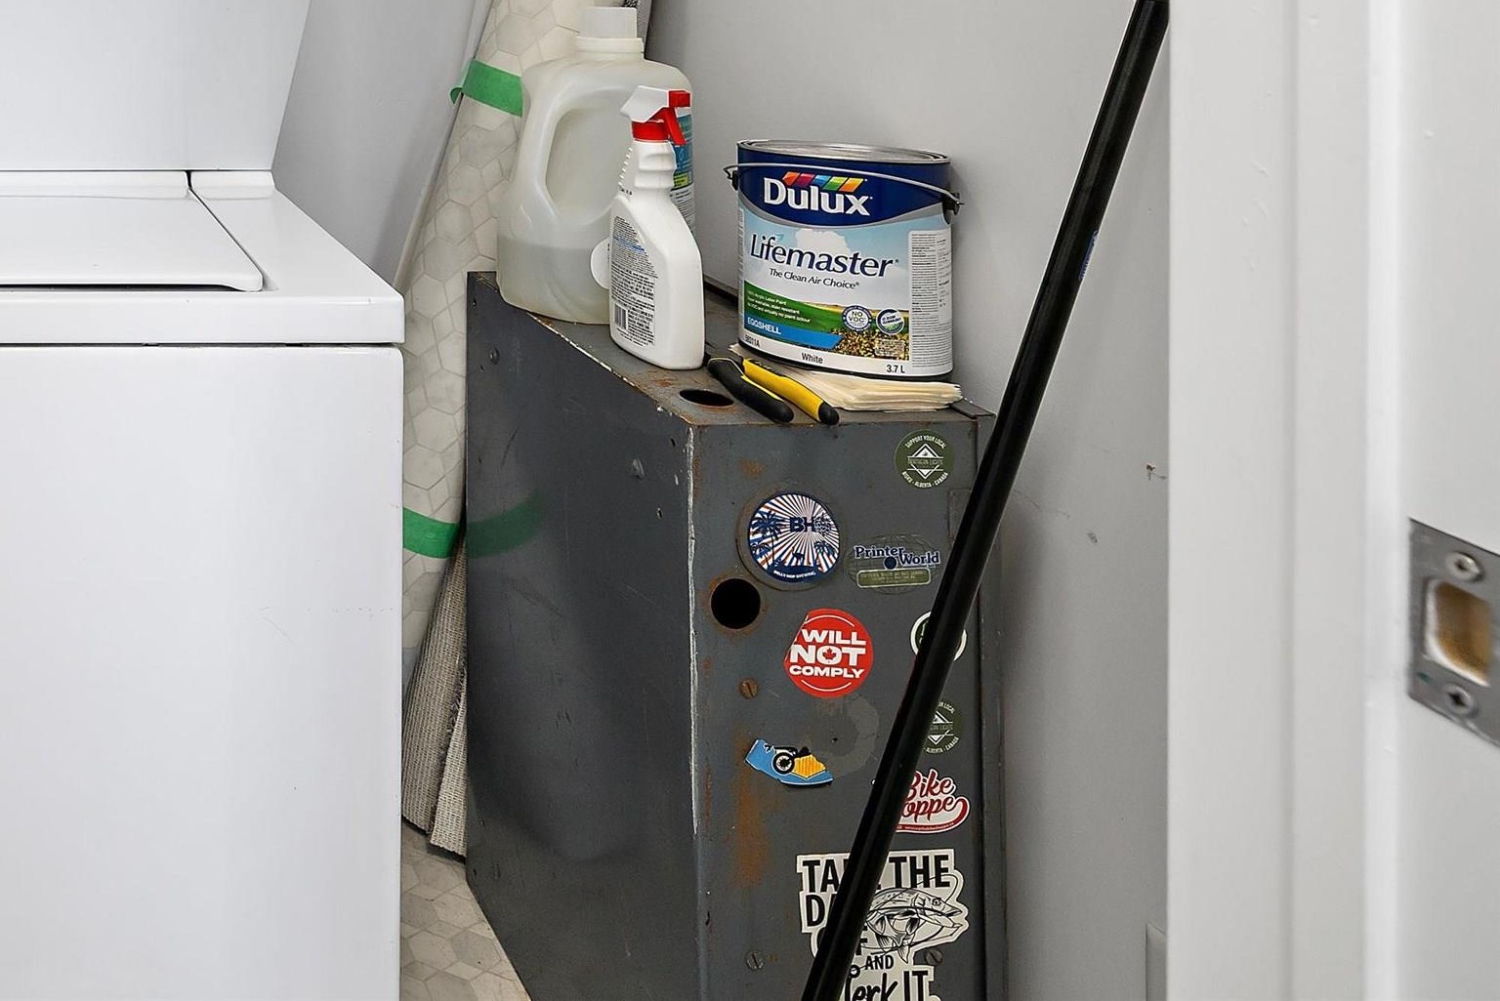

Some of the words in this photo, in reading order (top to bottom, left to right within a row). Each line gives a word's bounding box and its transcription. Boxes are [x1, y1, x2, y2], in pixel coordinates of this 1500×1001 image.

[763, 177, 871, 216] Dulux
[750, 233, 894, 277] Lifemaster
[769, 268, 783, 278] The
[784, 271, 808, 284] Clean
[808, 275, 821, 286] Air
[747, 317, 781, 335] EGGSHELL
[801, 352, 824, 364] White
[886, 364, 898, 373] 3.7
[900, 364, 906, 374] L
[904, 435, 923, 448] SUPPORT
[934, 438, 947, 449] LOCAL
[934, 472, 949, 486] CANADA
[790, 516, 816, 532] BH
[854, 546, 905, 558] Printer
[900, 551, 940, 566] World
[801, 629, 866, 646] WILL
[790, 644, 866, 666] NOT
[789, 666, 864, 679] COMPLY
[902, 796, 955, 823] oppe
[802, 858, 881, 892] TA
[889, 854, 950, 888] THE
[864, 955, 894, 970] AND
[904, 970, 928, 1001] IT
